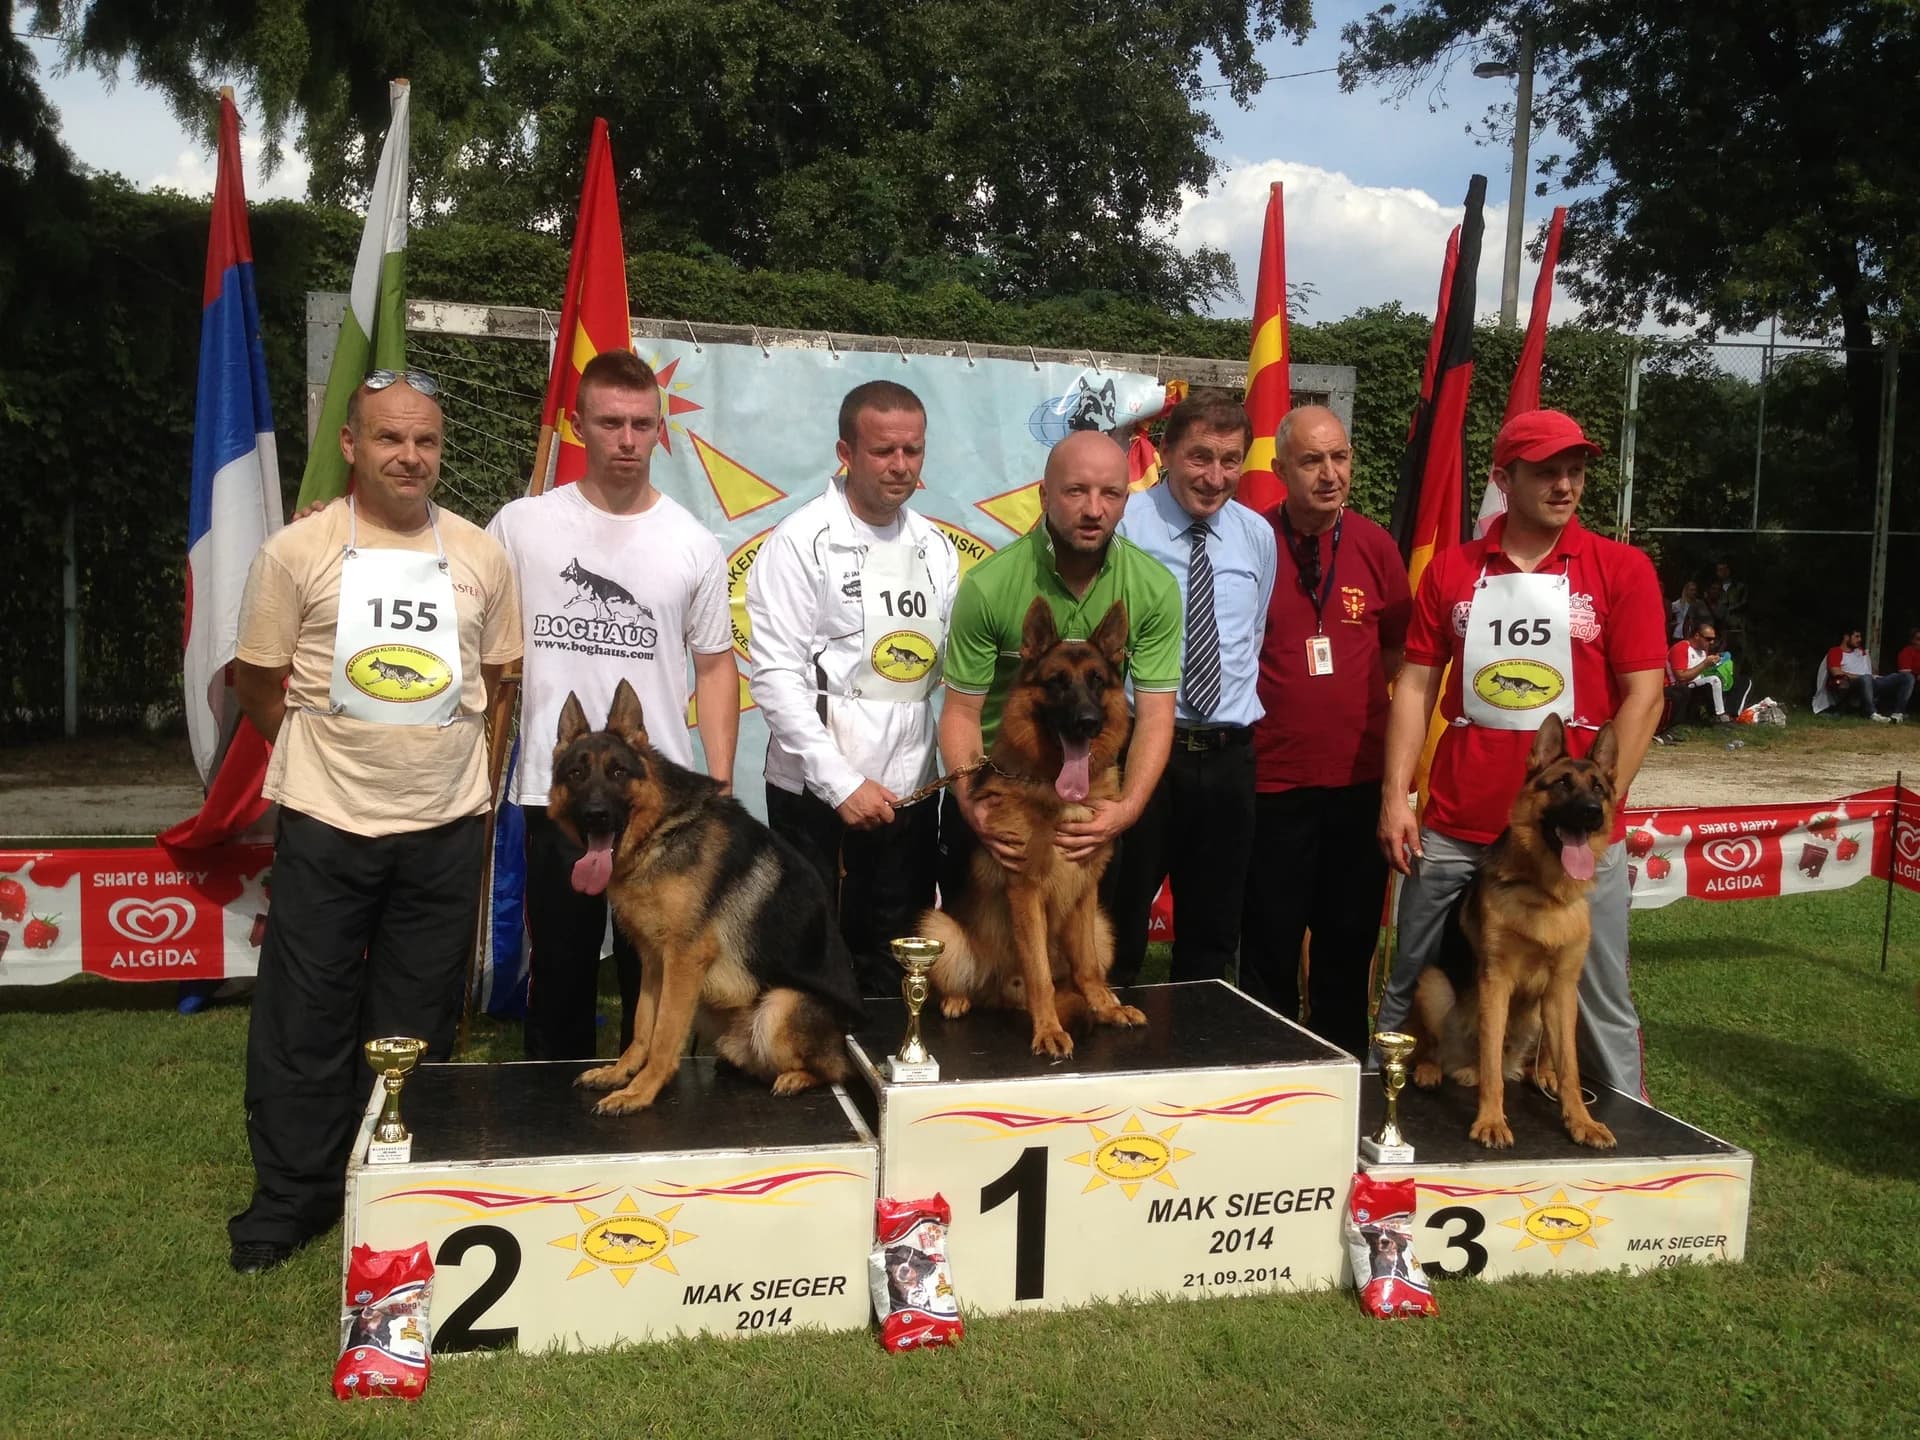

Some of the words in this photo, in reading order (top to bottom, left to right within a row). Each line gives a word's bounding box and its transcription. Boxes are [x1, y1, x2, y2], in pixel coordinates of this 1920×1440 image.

[728, 542, 764, 598] AKED
[941, 529, 985, 560] NSKI
[367, 597, 438, 632] 155
[880, 590, 926, 618] 160
[534, 614, 658, 648] BOGHAUS
[1488, 618, 1552, 646] 165
[534, 640, 654, 660] www.boghaus.com
[1147, 1197, 1215, 1224] MAK
[1224, 1186, 1336, 1217] SIEGER
[980, 1146, 1048, 1301] 1
[1209, 1226, 1274, 1255] 2014
[1421, 1206, 1489, 1279] 3
[1627, 1238, 1665, 1251] MAK
[1668, 1235, 1728, 1250] SIEGER
[432, 1224, 521, 1354] 2
[682, 1282, 743, 1306] MAK
[750, 1275, 848, 1302] SIEGER
[1183, 1265, 1292, 1288] 21.09.2014
[736, 1306, 792, 1331] 2014
